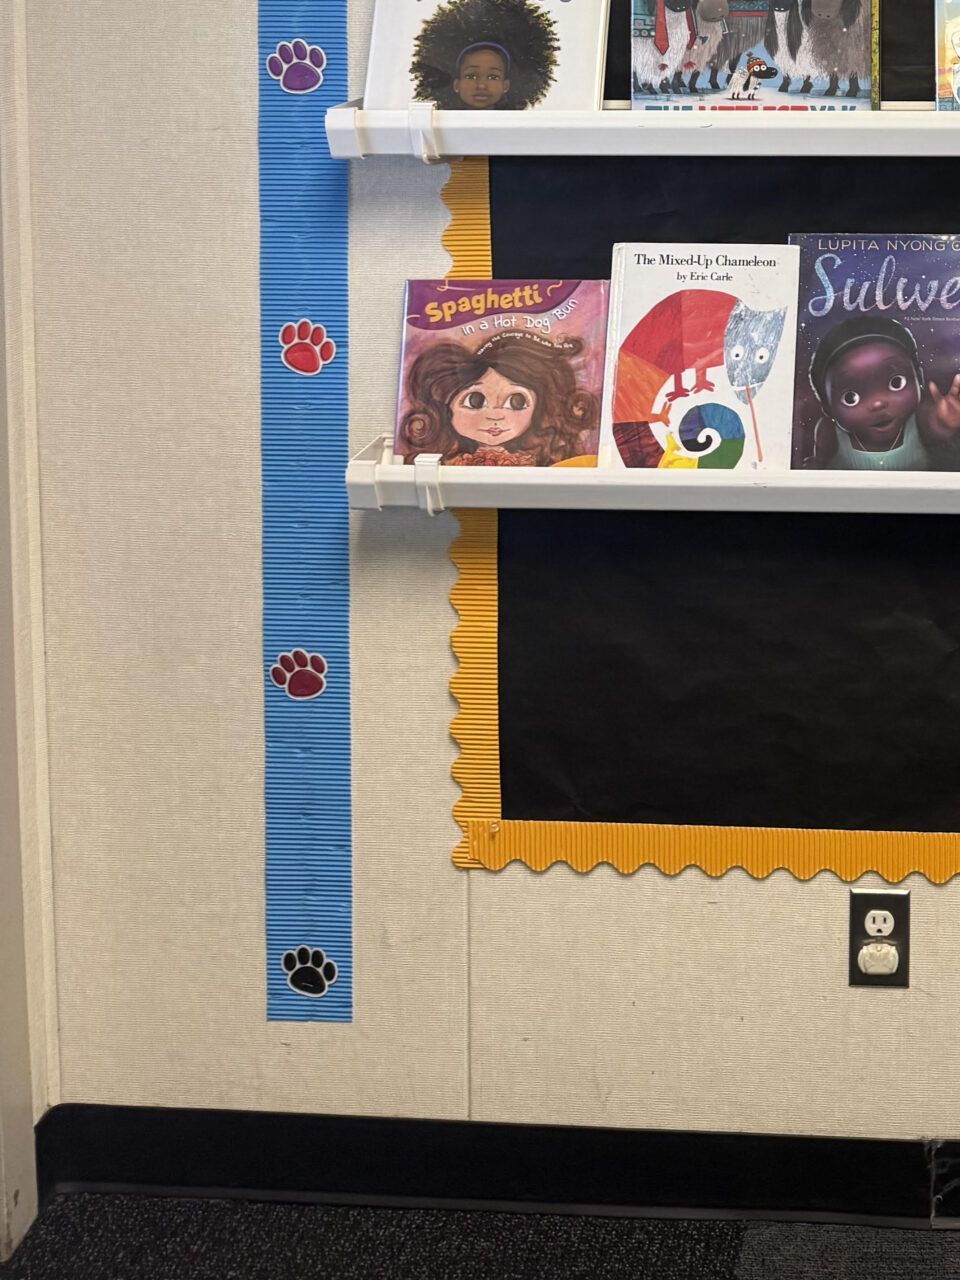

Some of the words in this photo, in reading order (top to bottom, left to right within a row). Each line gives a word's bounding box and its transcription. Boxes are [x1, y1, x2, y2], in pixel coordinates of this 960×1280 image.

[818, 239, 879, 251] LUPITA
[634, 253, 656, 266] The
[658, 254, 713, 269] Mixed-Up
[715, 255, 777, 268] Chameleon
[676, 272, 687, 282] by
[690, 272, 708, 281] Eric
[710, 272, 733, 282] Carle
[424, 284, 543, 323] Spaghetti
[480, 321, 489, 330] a
[494, 315, 517, 327] Hot
[523, 316, 551, 333] Dog
[552, 299, 578, 321] Bun
